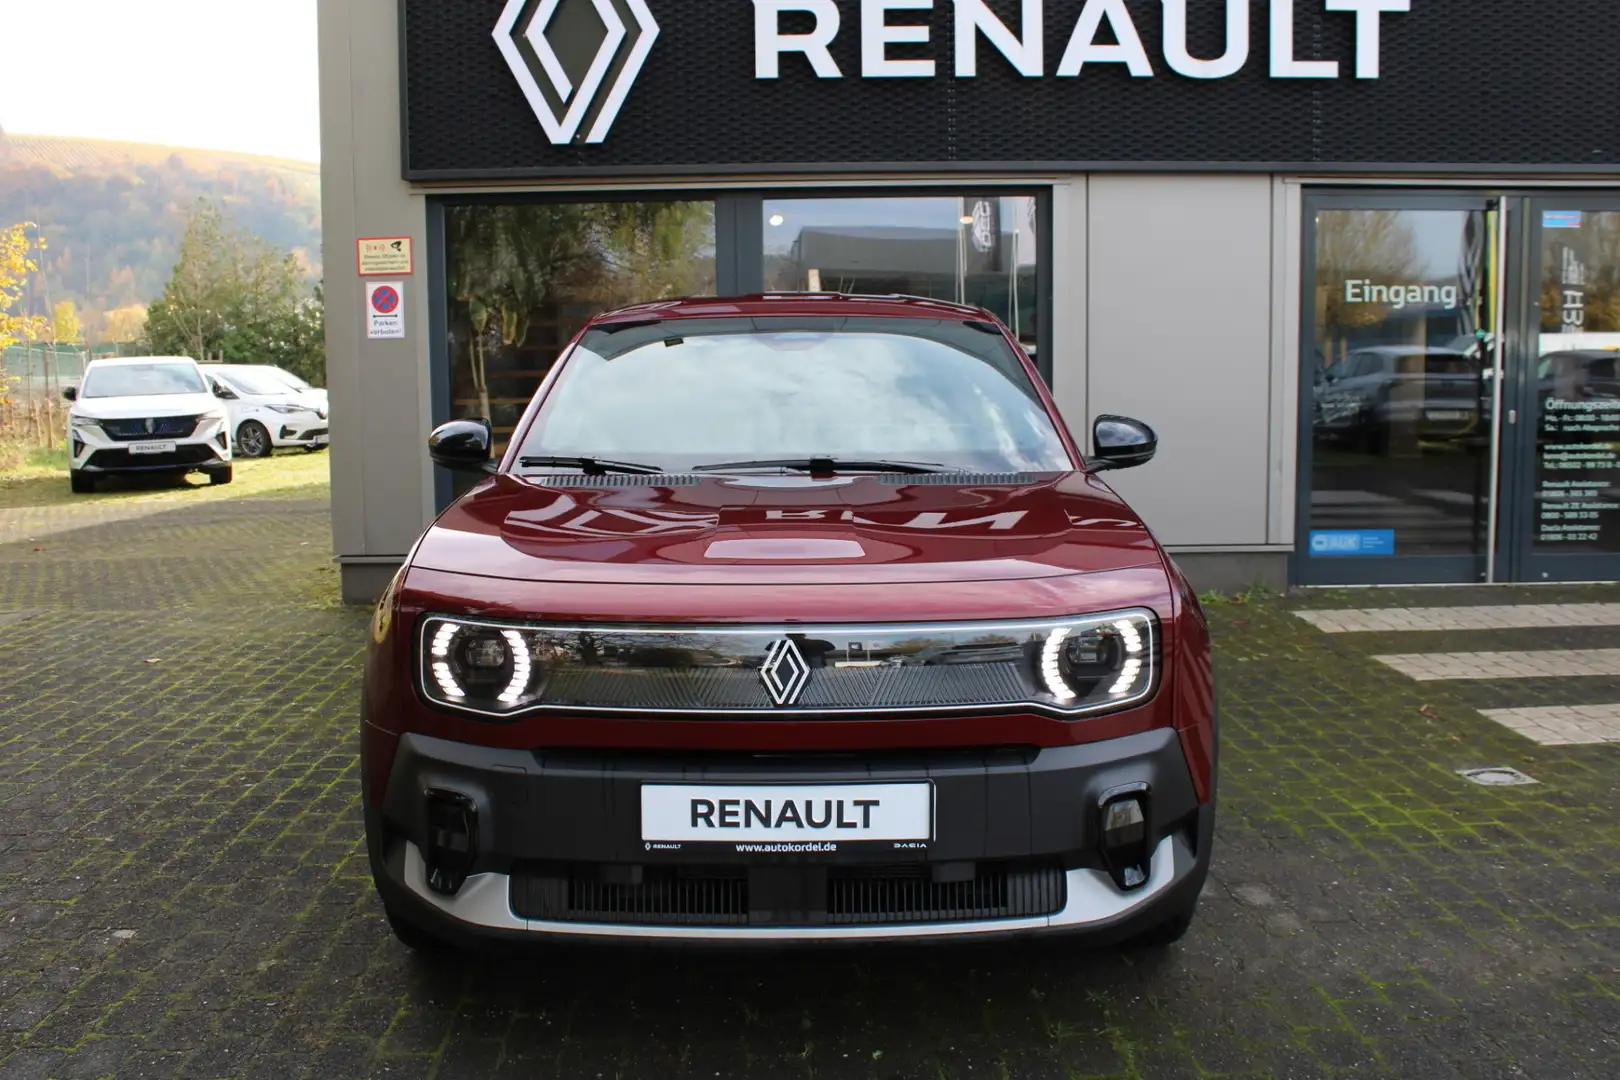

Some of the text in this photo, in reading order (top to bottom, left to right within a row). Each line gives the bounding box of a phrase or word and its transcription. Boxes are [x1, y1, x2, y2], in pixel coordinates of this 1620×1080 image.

[755, 0, 1411, 79] RENAULT
[1345, 279, 1457, 309] Eingang
[690, 798, 880, 829] RENAULT
[735, 842, 837, 852] www.autokordel.de
